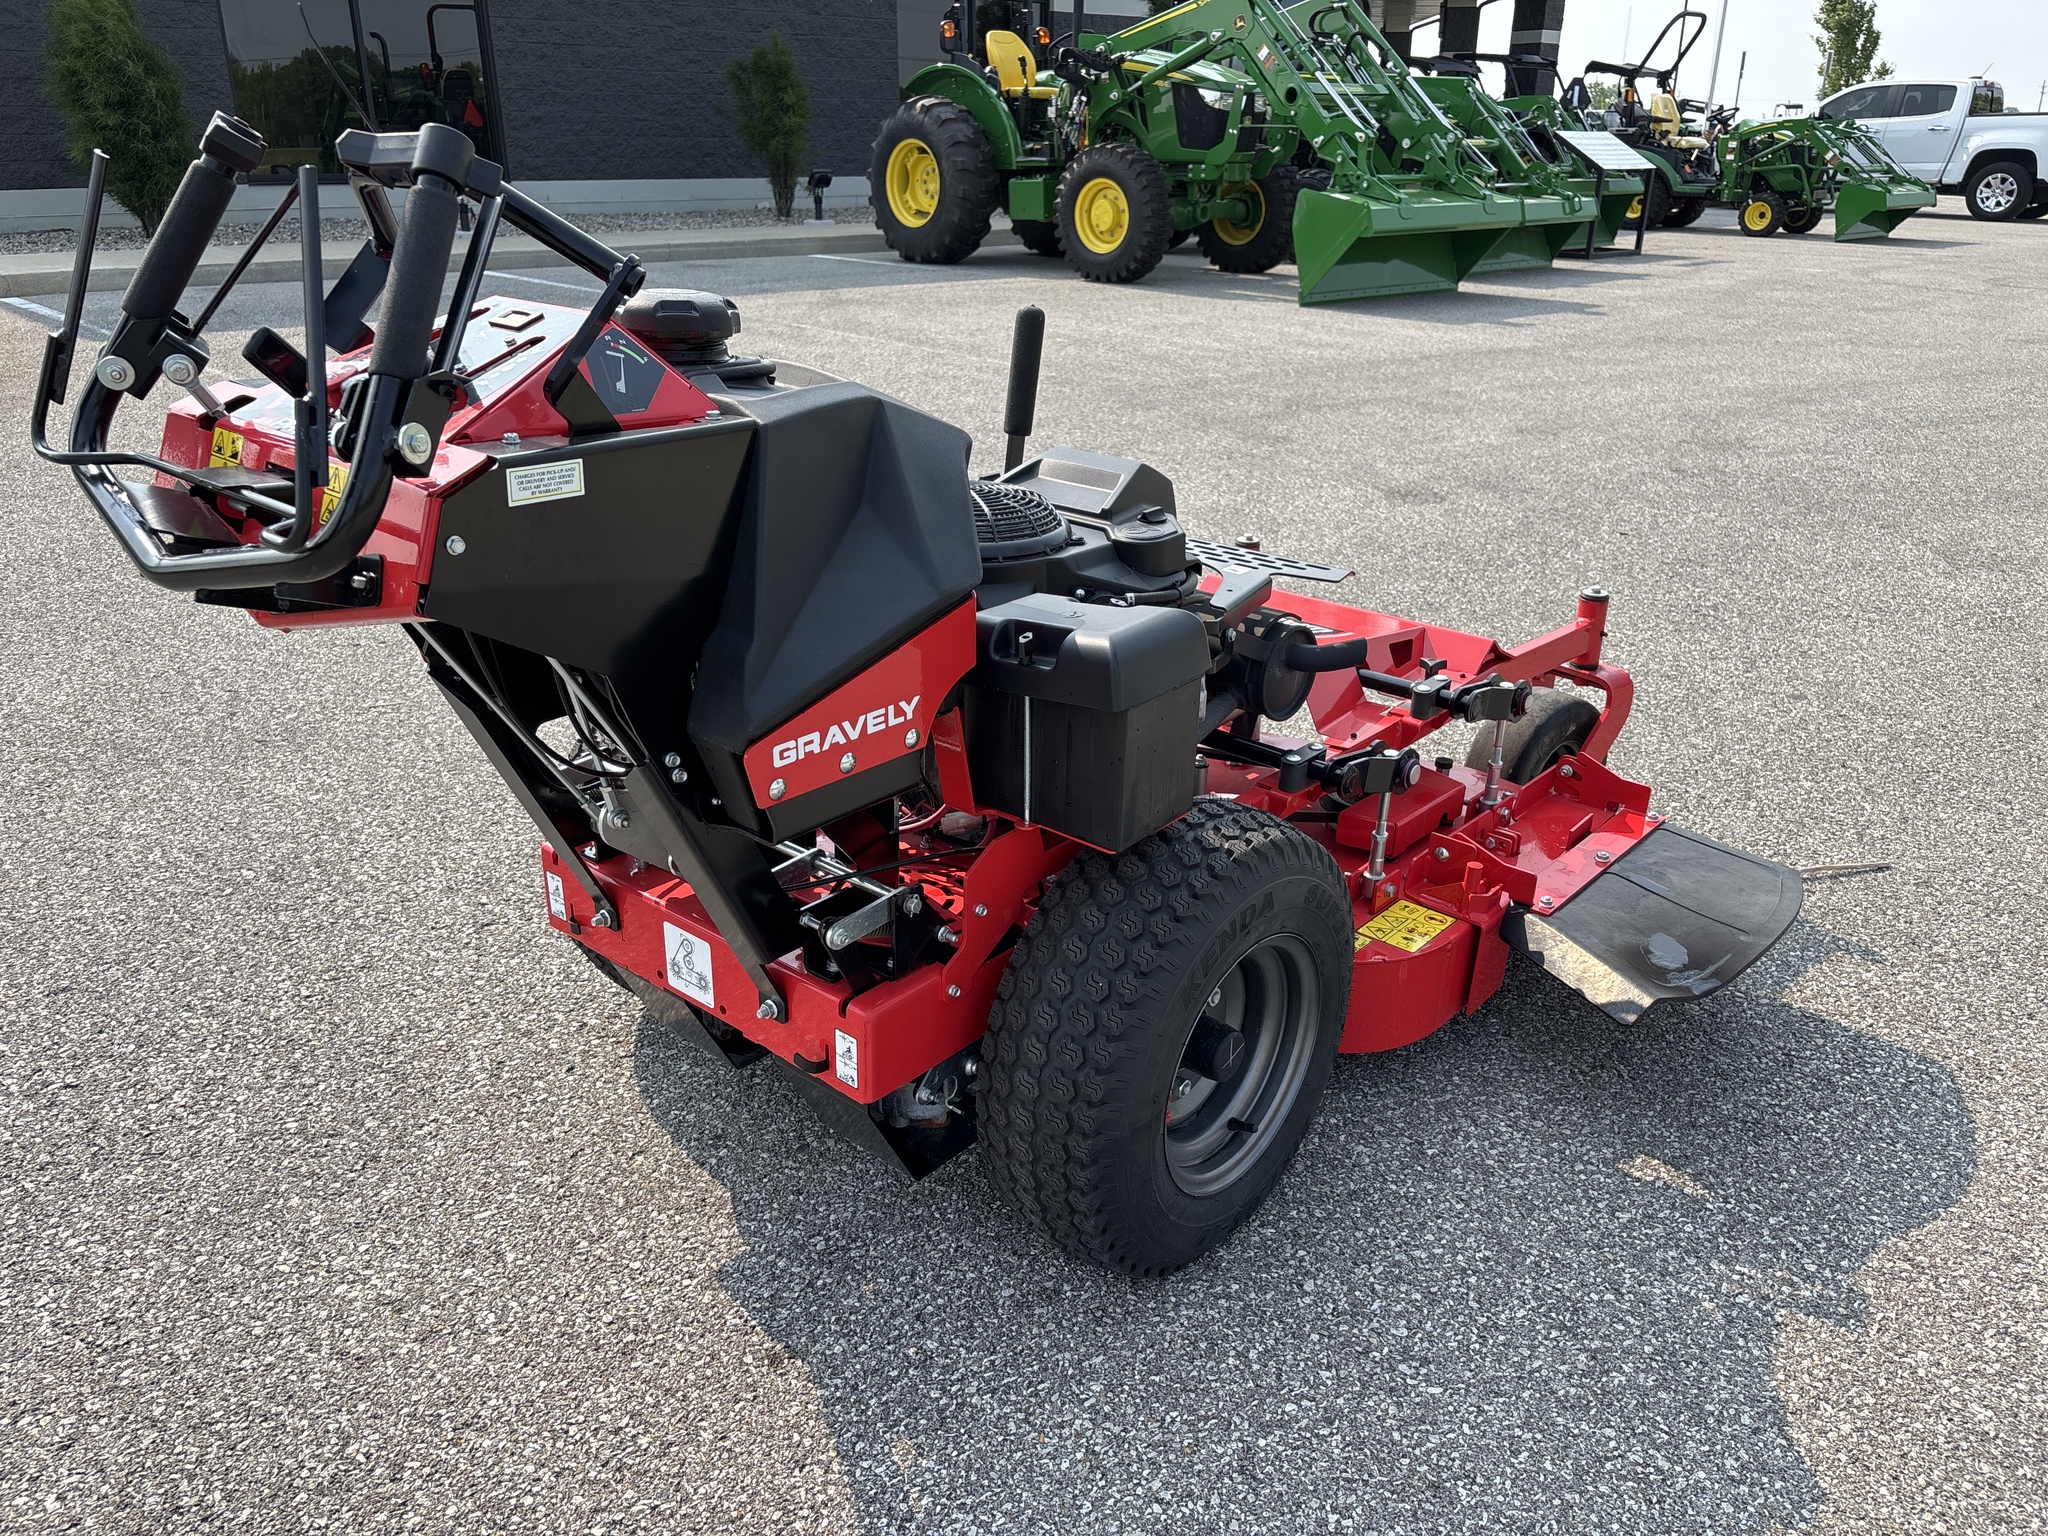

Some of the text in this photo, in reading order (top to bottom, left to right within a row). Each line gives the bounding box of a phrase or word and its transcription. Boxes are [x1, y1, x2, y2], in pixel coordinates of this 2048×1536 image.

[525, 477, 546, 485] DELIVERY
[538, 487, 563, 495] WARRANTY
[553, 479, 574, 487] COVERED
[772, 694, 921, 769] GRAVELY
[1303, 882, 1351, 960] SUPER
[1177, 890, 1276, 1011] KENDA
